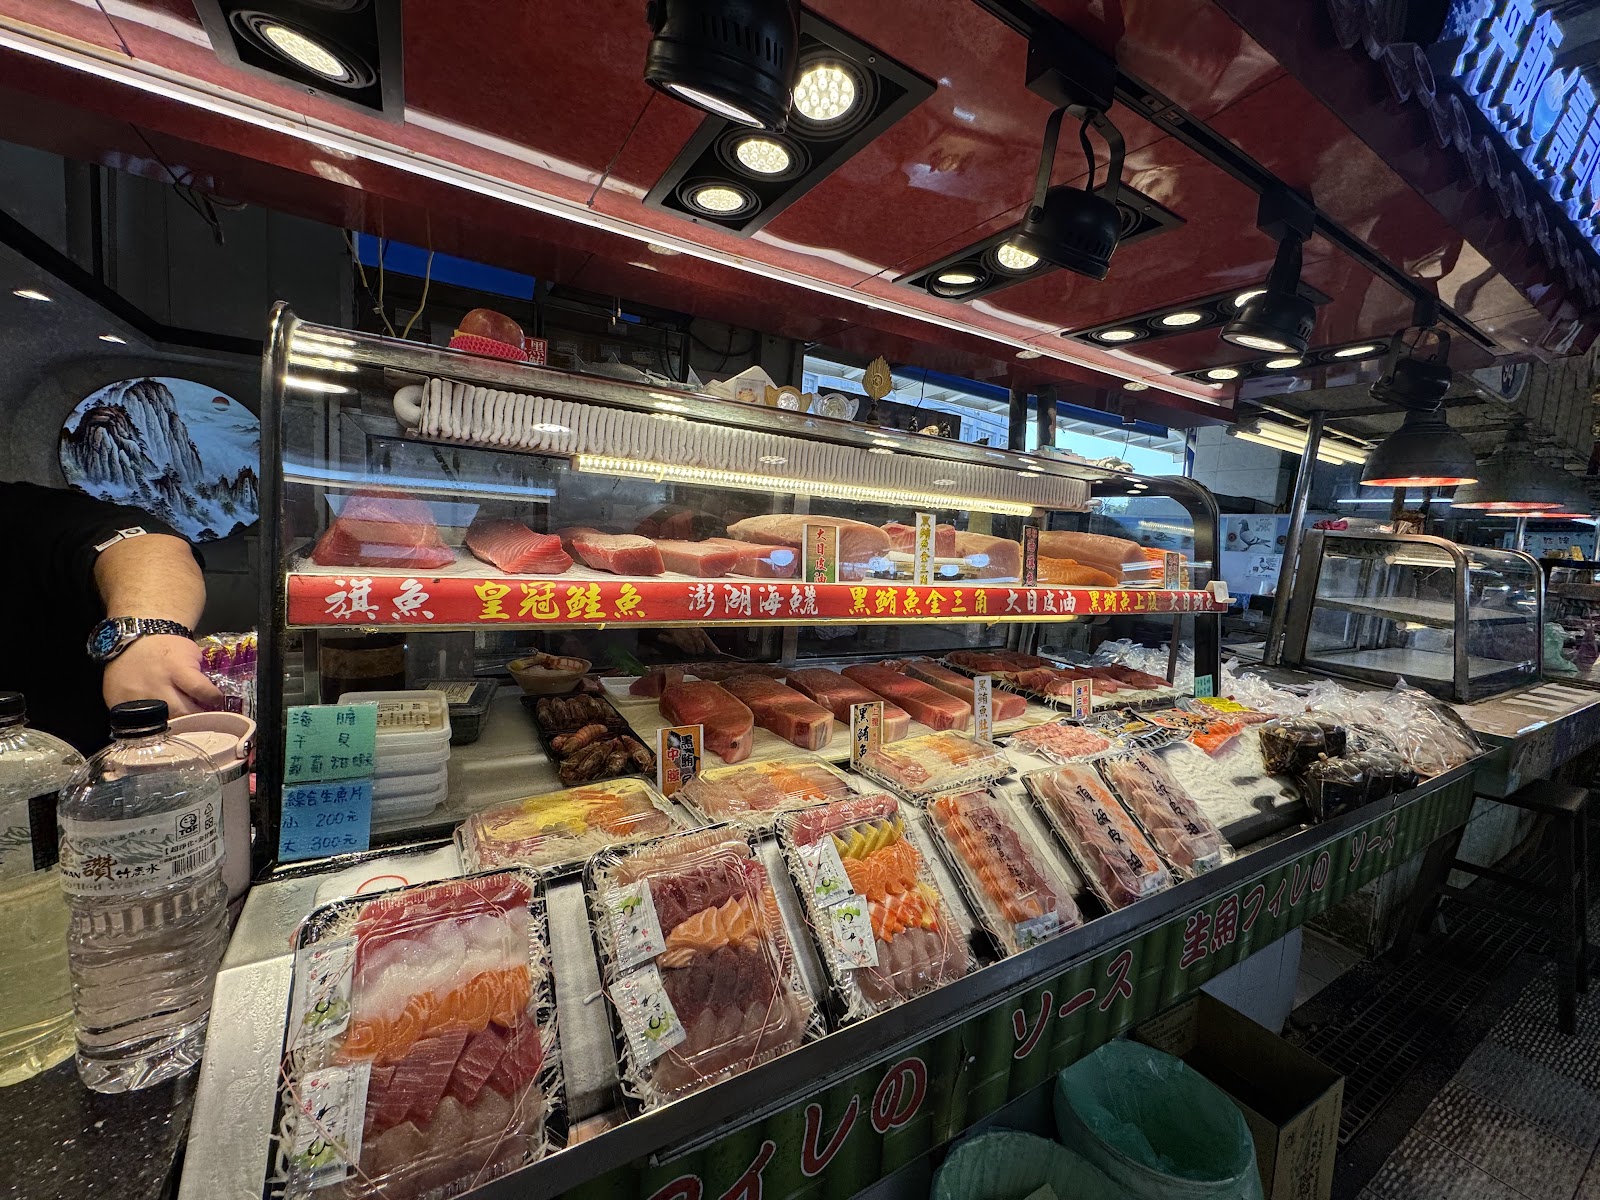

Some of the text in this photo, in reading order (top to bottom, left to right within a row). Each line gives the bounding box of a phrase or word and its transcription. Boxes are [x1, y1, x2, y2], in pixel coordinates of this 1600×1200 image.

[814, 528, 827, 583] 大目皮油
[324, 577, 1214, 621] 旗魚 皇冠鮭魚 澎湖海鱺 黑鮪魚金三角 大目皮油 黑鮪魚上腹 大目鮪魚
[667, 748, 680, 783] 中腹
[285, 787, 362, 807] 綜合生魚片
[316, 811, 359, 828] 200元
[1075, 785, 1142, 872] 頂級皮油
[283, 834, 357, 853] 大 300元
[1349, 815, 1397, 872] ソース
[116, 863, 160, 879] 竹炭水
[1012, 948, 1135, 1062] ソース
